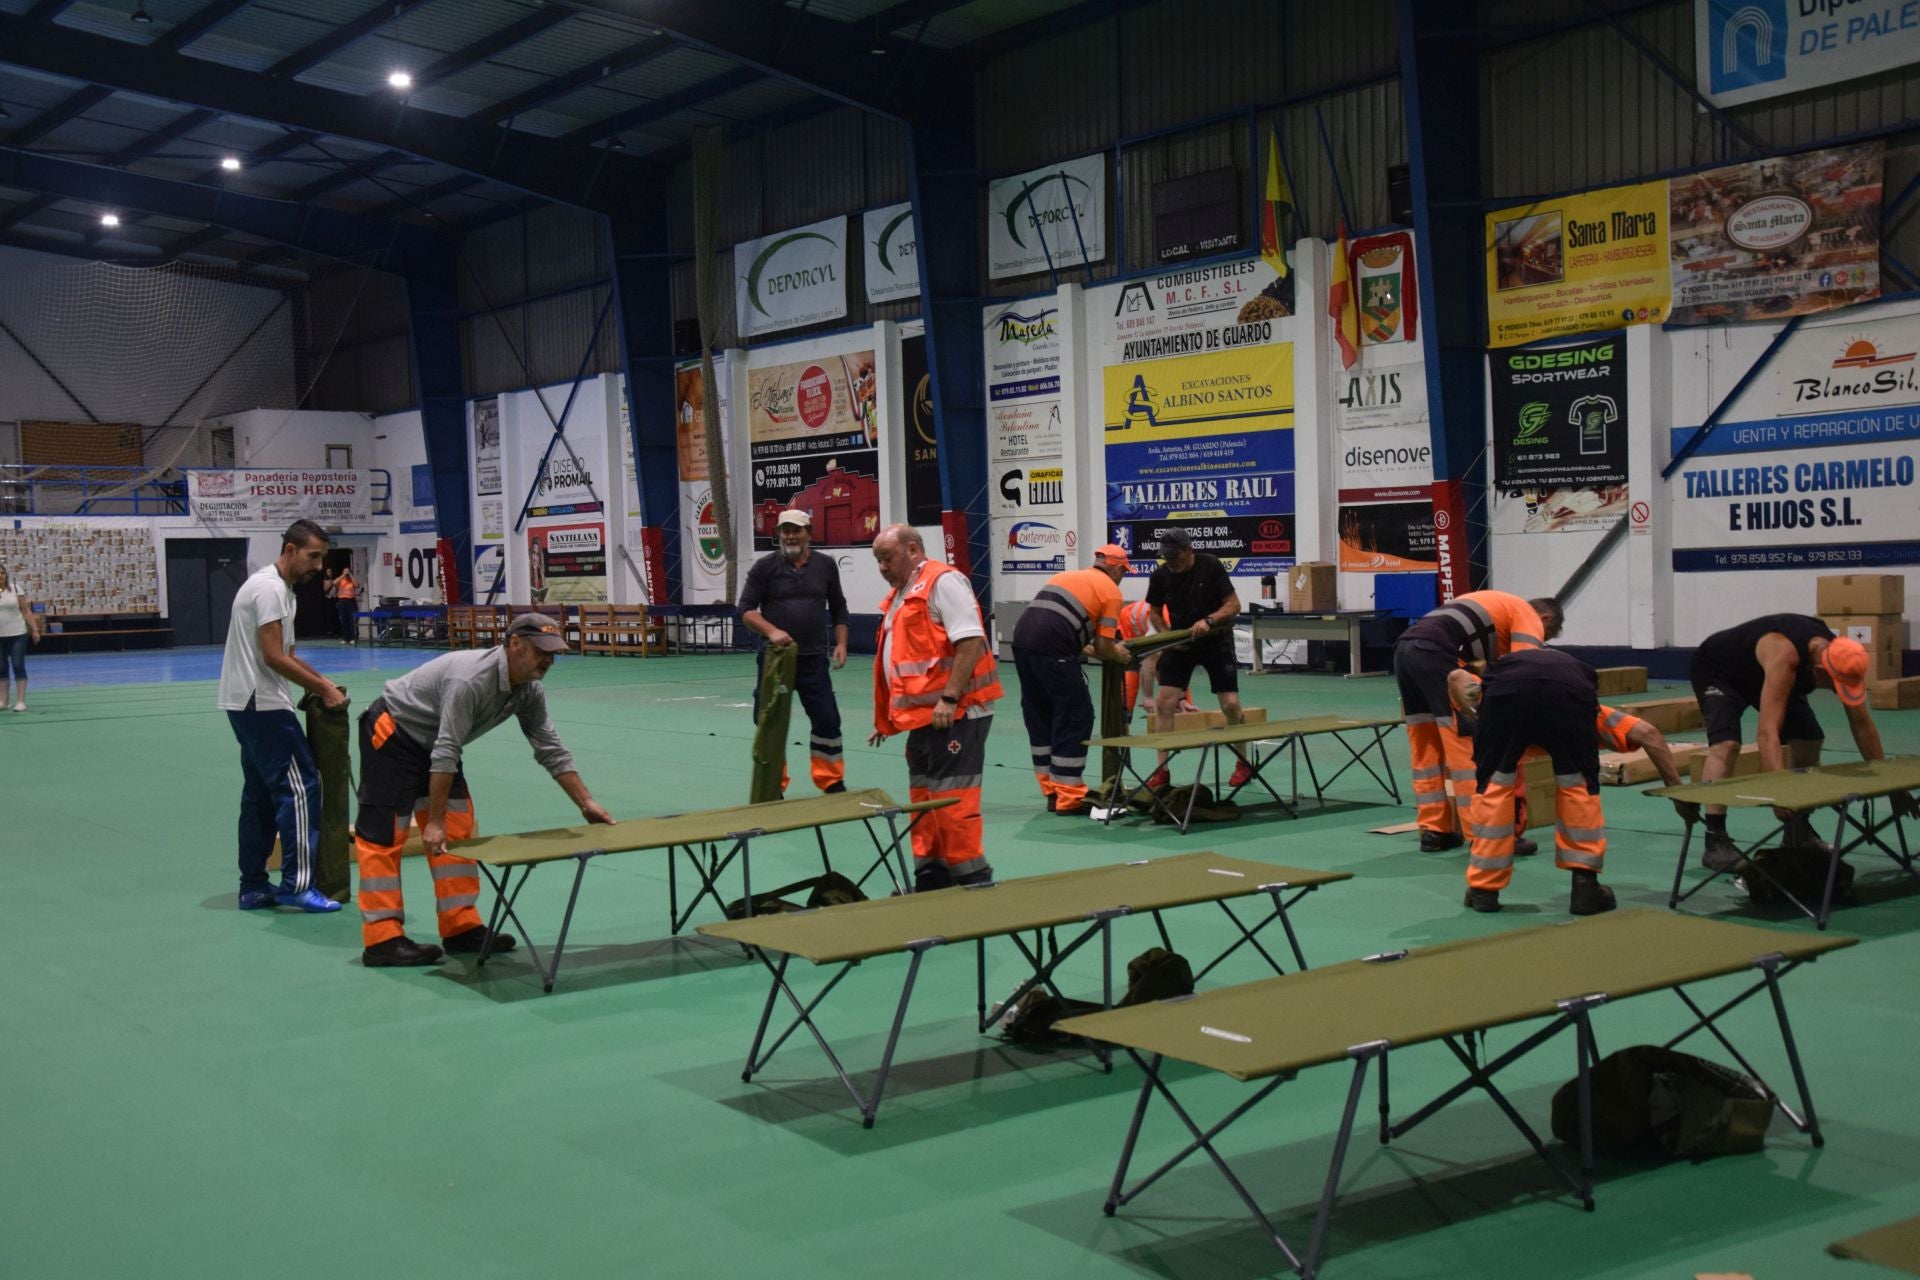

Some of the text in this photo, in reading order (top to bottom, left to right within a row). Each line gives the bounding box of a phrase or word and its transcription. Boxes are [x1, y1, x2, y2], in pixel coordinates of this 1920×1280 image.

[1799, 0, 1863, 18] Dip
[1800, 0, 1920, 56] DE PALE
[1567, 211, 1656, 249] Santa Marta
[1733, 210, 1806, 234] Santa Marta
[1160, 233, 1239, 259] LOCAL VISITANTE
[767, 263, 838, 296] DEPORCYL
[1156, 260, 1256, 291] COMBUSTIBLES
[1589, 280, 1618, 293] Tortillas
[1619, 276, 1655, 290] Variadas
[1224, 279, 1248, 297] S.L.
[1000, 309, 1053, 345] Maseda
[1123, 331, 1203, 362] AYUNTAMIENTO
[1206, 328, 1220, 349] DE
[1222, 320, 1272, 347] GUARDO
[1508, 345, 1615, 371] GDESING
[1182, 375, 1252, 391] EXCAVACIONES
[1511, 365, 1612, 385] SPORTWEAR
[1163, 385, 1273, 409] ALBINO SANTOS
[1339, 371, 1402, 408] AXIS
[1008, 434, 1029, 447] HOTEL
[1733, 428, 1777, 449] VENTA
[1780, 427, 1793, 444] Y
[1794, 415, 1881, 442] REPARACIÓN
[1885, 414, 1905, 433] DE
[1192, 442, 1220, 452] GUARDO
[1220, 438, 1248, 451] (Palencia)
[1512, 436, 1551, 447] DESING
[914, 449, 939, 462] SAN
[1001, 447, 1030, 459] Restaurante
[1345, 446, 1431, 467] disenove
[765, 463, 802, 476] 979.850.991
[1139, 459, 1257, 476] www.excavacionesalbinosantos.com
[554, 471, 593, 489] PROMAIL
[765, 476, 803, 489] 979.891.328
[1586, 474, 1625, 483] IDENTIDAD
[1683, 455, 1915, 499] TALLERES CARMELO
[250, 481, 356, 496] JESÚS HERAS
[1121, 477, 1279, 505] TALLERES RAUL
[1374, 488, 1421, 498] www.disenove.com
[199, 500, 352, 511] DEGUSTACIÓN OBRADOR
[1729, 496, 1862, 531] E HIJOS S.L.
[549, 533, 599, 543] SANTILLANA
[698, 527, 712, 535] YOLI
[1203, 526, 1229, 538] EN 4X4
[1262, 524, 1280, 536] KIA
[1205, 539, 1244, 552] MULTIMARCA
[1808, 548, 1863, 562] 979.852.133
[408, 547, 437, 589] OT
